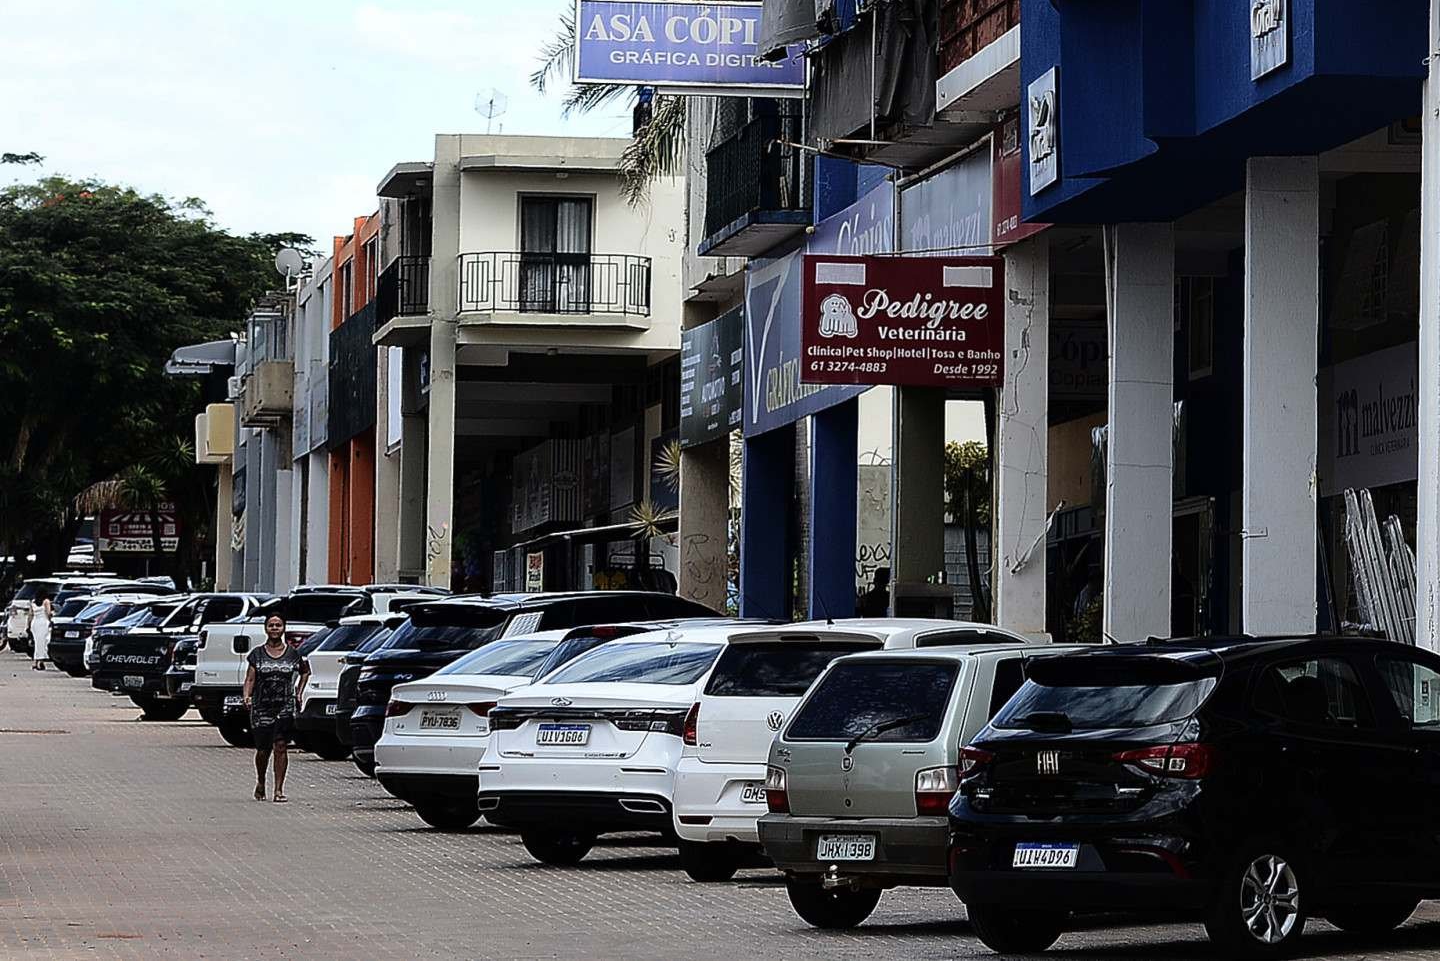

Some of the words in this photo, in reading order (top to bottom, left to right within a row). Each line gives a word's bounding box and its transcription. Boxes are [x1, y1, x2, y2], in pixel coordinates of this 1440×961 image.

[584, 14, 656, 42] ASA
[609, 48, 700, 66] GRÁFICA
[857, 289, 989, 329] Pedigree
[878, 325, 966, 342] Veterinária
[807, 345, 842, 357] Clínica
[846, 347, 864, 358] Pet
[867, 347, 893, 360] Shop
[897, 347, 926, 359] Hotel
[932, 348, 954, 360] Tosa
[958, 351, 964, 359] e
[967, 348, 1001, 360] Banho
[810, 360, 825, 372] 61
[827, 361, 887, 373] 3274-4883
[934, 363, 968, 374] Desde
[970, 364, 998, 375] 1992
[1362, 376, 1416, 437] malvezzi
[105, 654, 160, 665] CHEVROLET
[1037, 750, 1059, 775] FIAT
